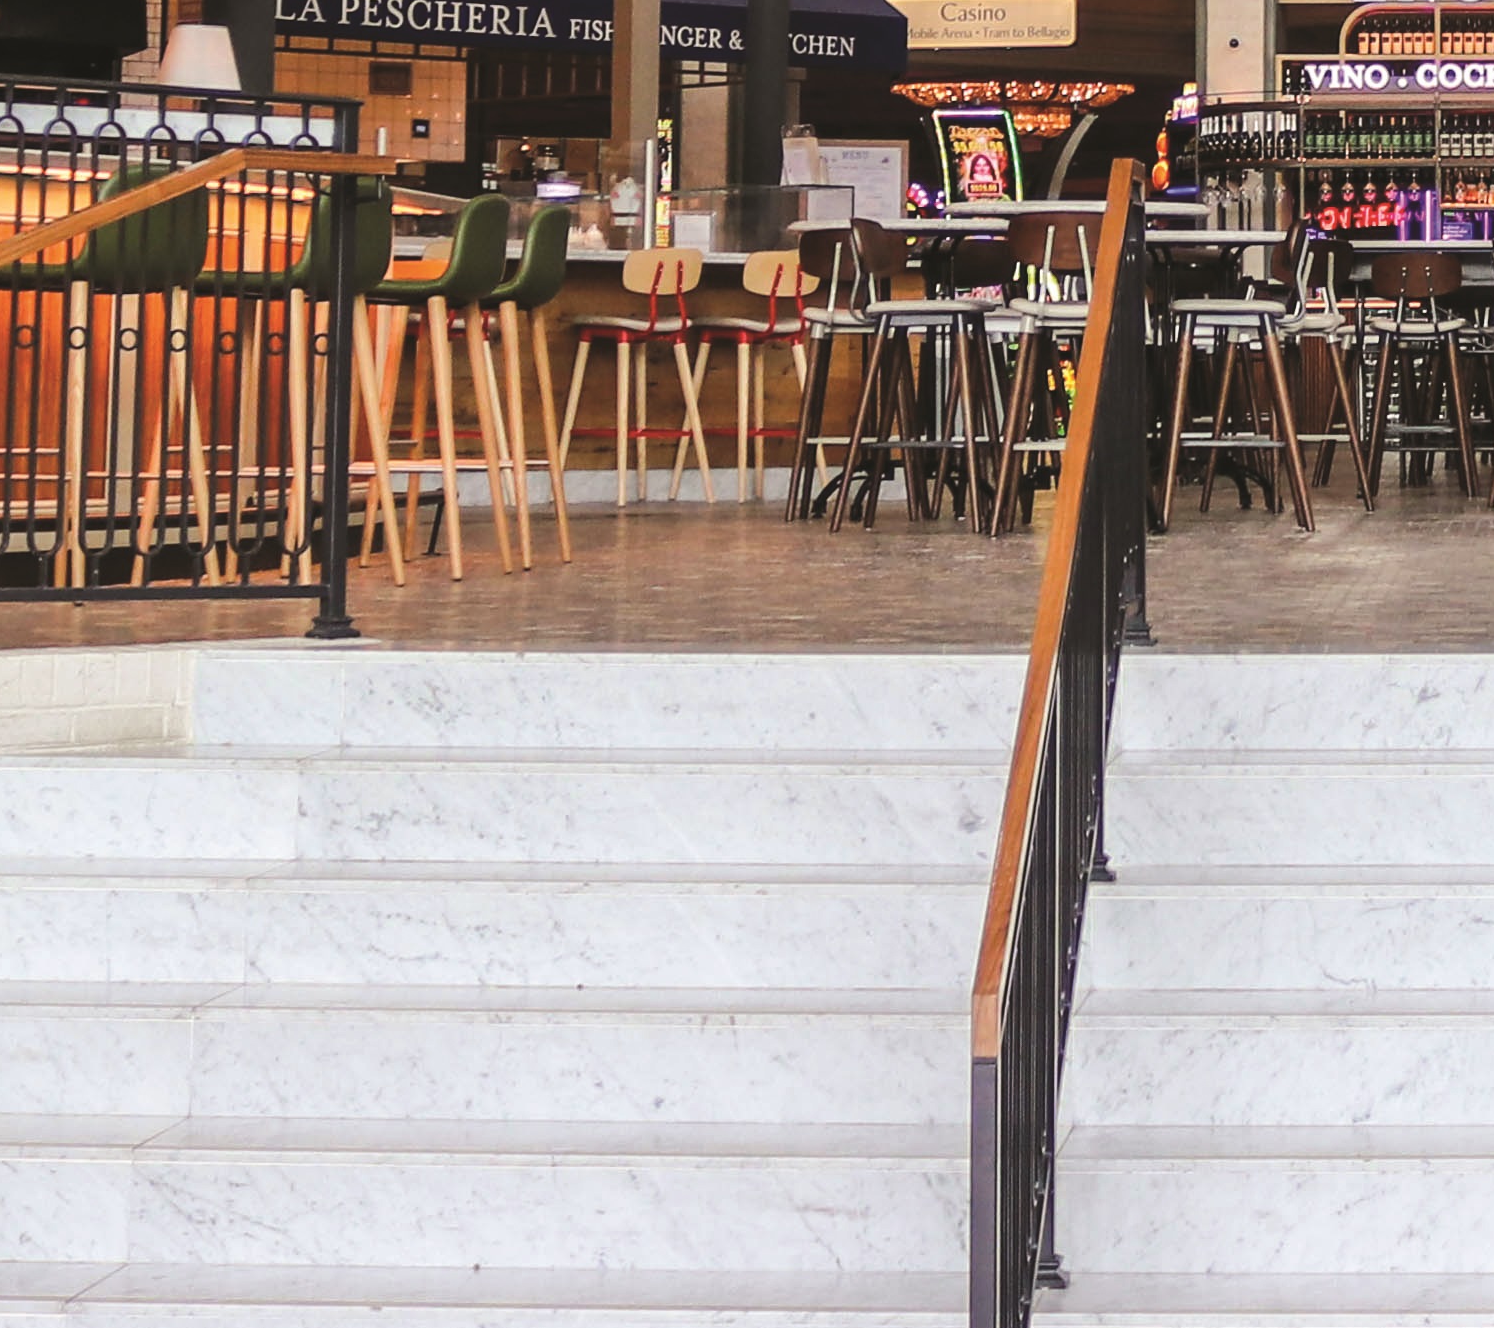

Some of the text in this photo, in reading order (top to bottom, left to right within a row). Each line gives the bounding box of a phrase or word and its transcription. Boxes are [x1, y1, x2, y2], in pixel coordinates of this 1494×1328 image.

[941, 2, 1007, 22] Casino
[569, 18, 723, 49] FISHNGER
[728, 29, 746, 51] &
[787, 33, 855, 57] CHEN
[942, 27, 973, 39] Arena
[983, 26, 1010, 39] Tram
[1013, 27, 1025, 38] to
[1027, 25, 1071, 40] Bellagio
[1305, 63, 1390, 90] VINO
